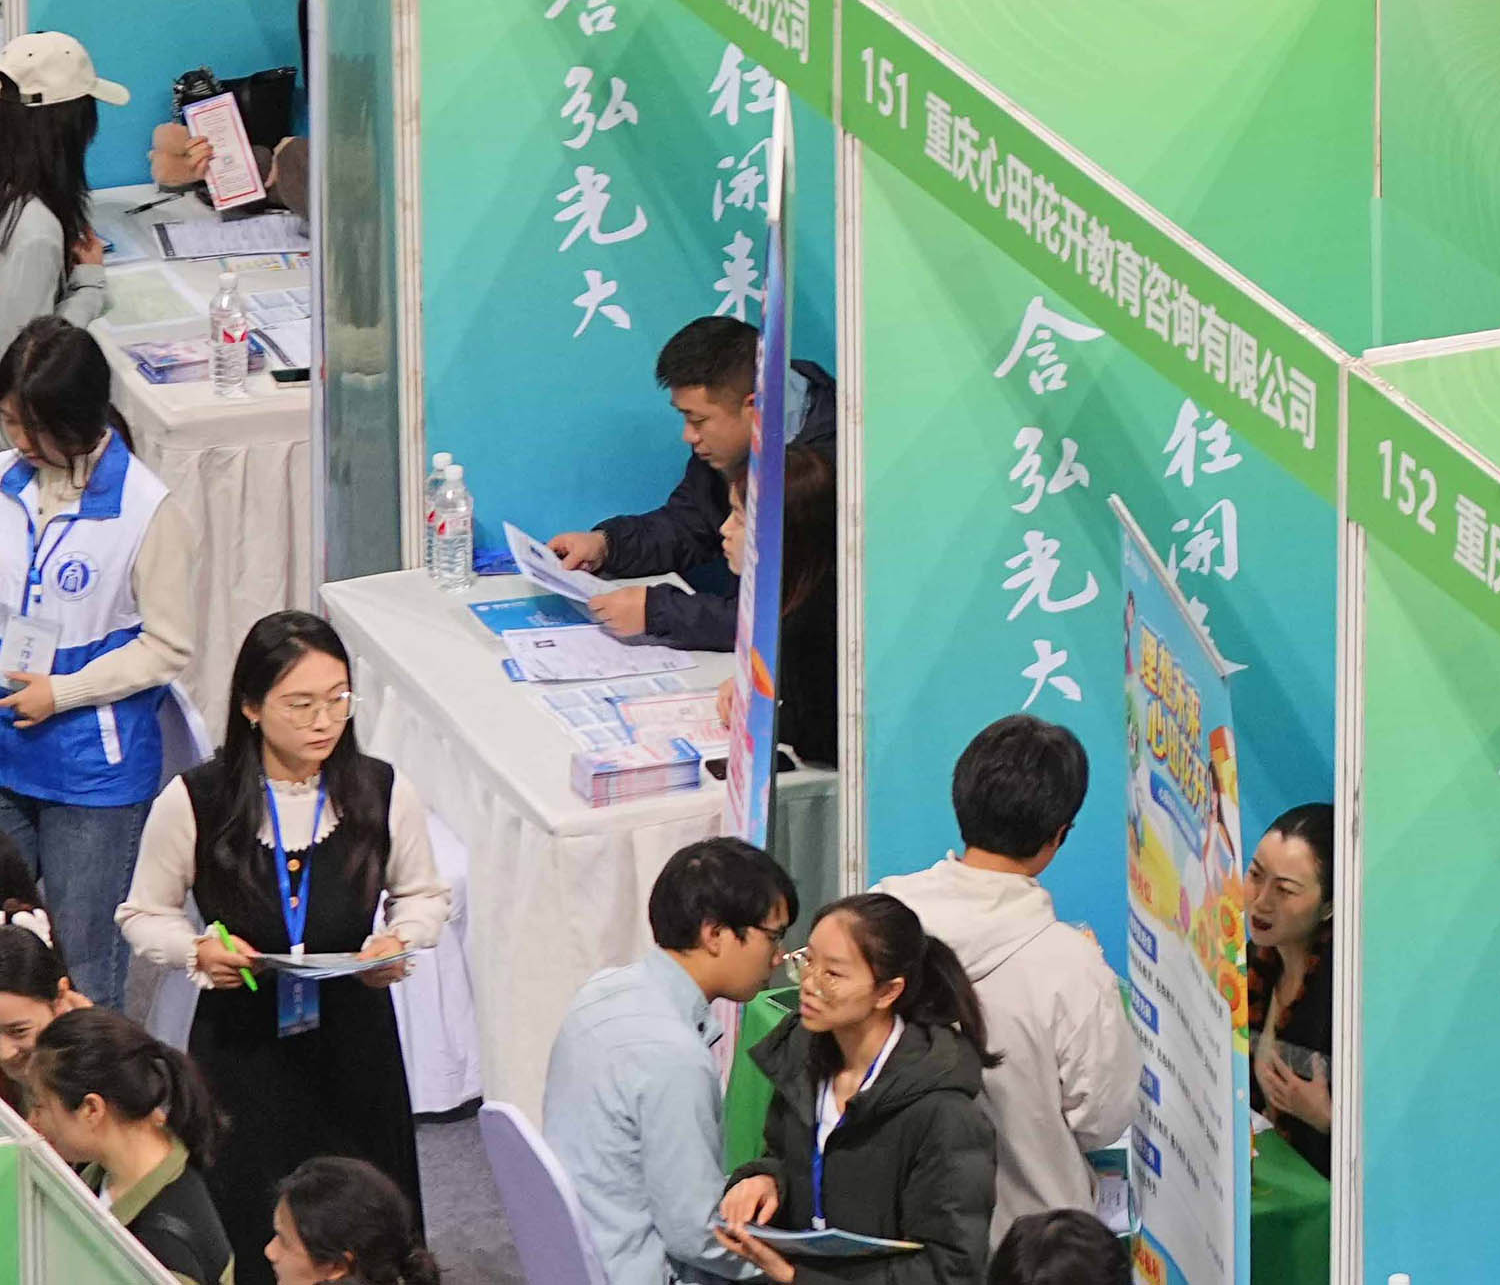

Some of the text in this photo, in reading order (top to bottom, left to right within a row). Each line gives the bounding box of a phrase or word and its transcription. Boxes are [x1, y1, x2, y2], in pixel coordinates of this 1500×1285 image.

[861, 48, 1317, 450] 151 重庆心田花开教育咨询有限公司
[1378, 440, 1435, 534] 152
